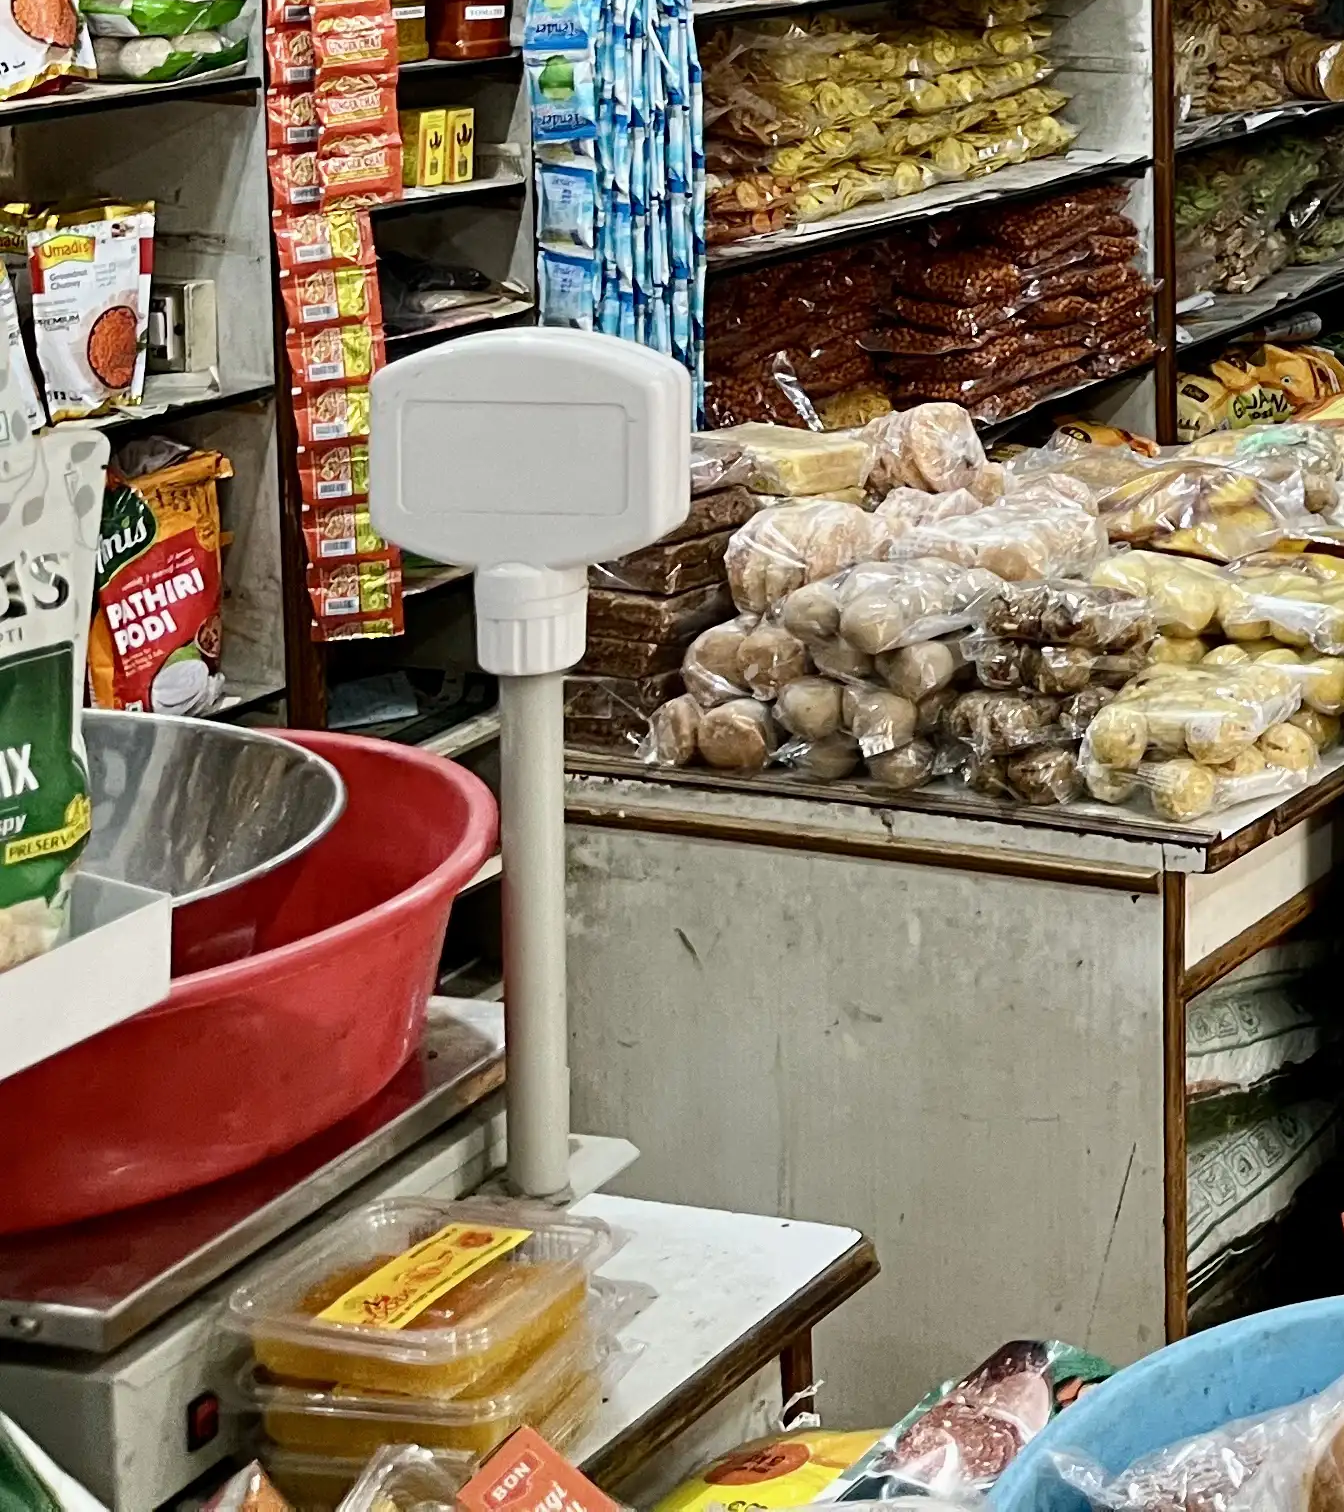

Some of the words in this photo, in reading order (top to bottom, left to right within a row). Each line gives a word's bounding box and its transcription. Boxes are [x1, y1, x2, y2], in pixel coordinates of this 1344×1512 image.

[536, 21, 576, 36] Tender
[540, 114, 581, 128] Tender
[106, 568, 204, 630] PATHIRI
[114, 609, 178, 656] PODI
[491, 1462, 532, 1502] BON
